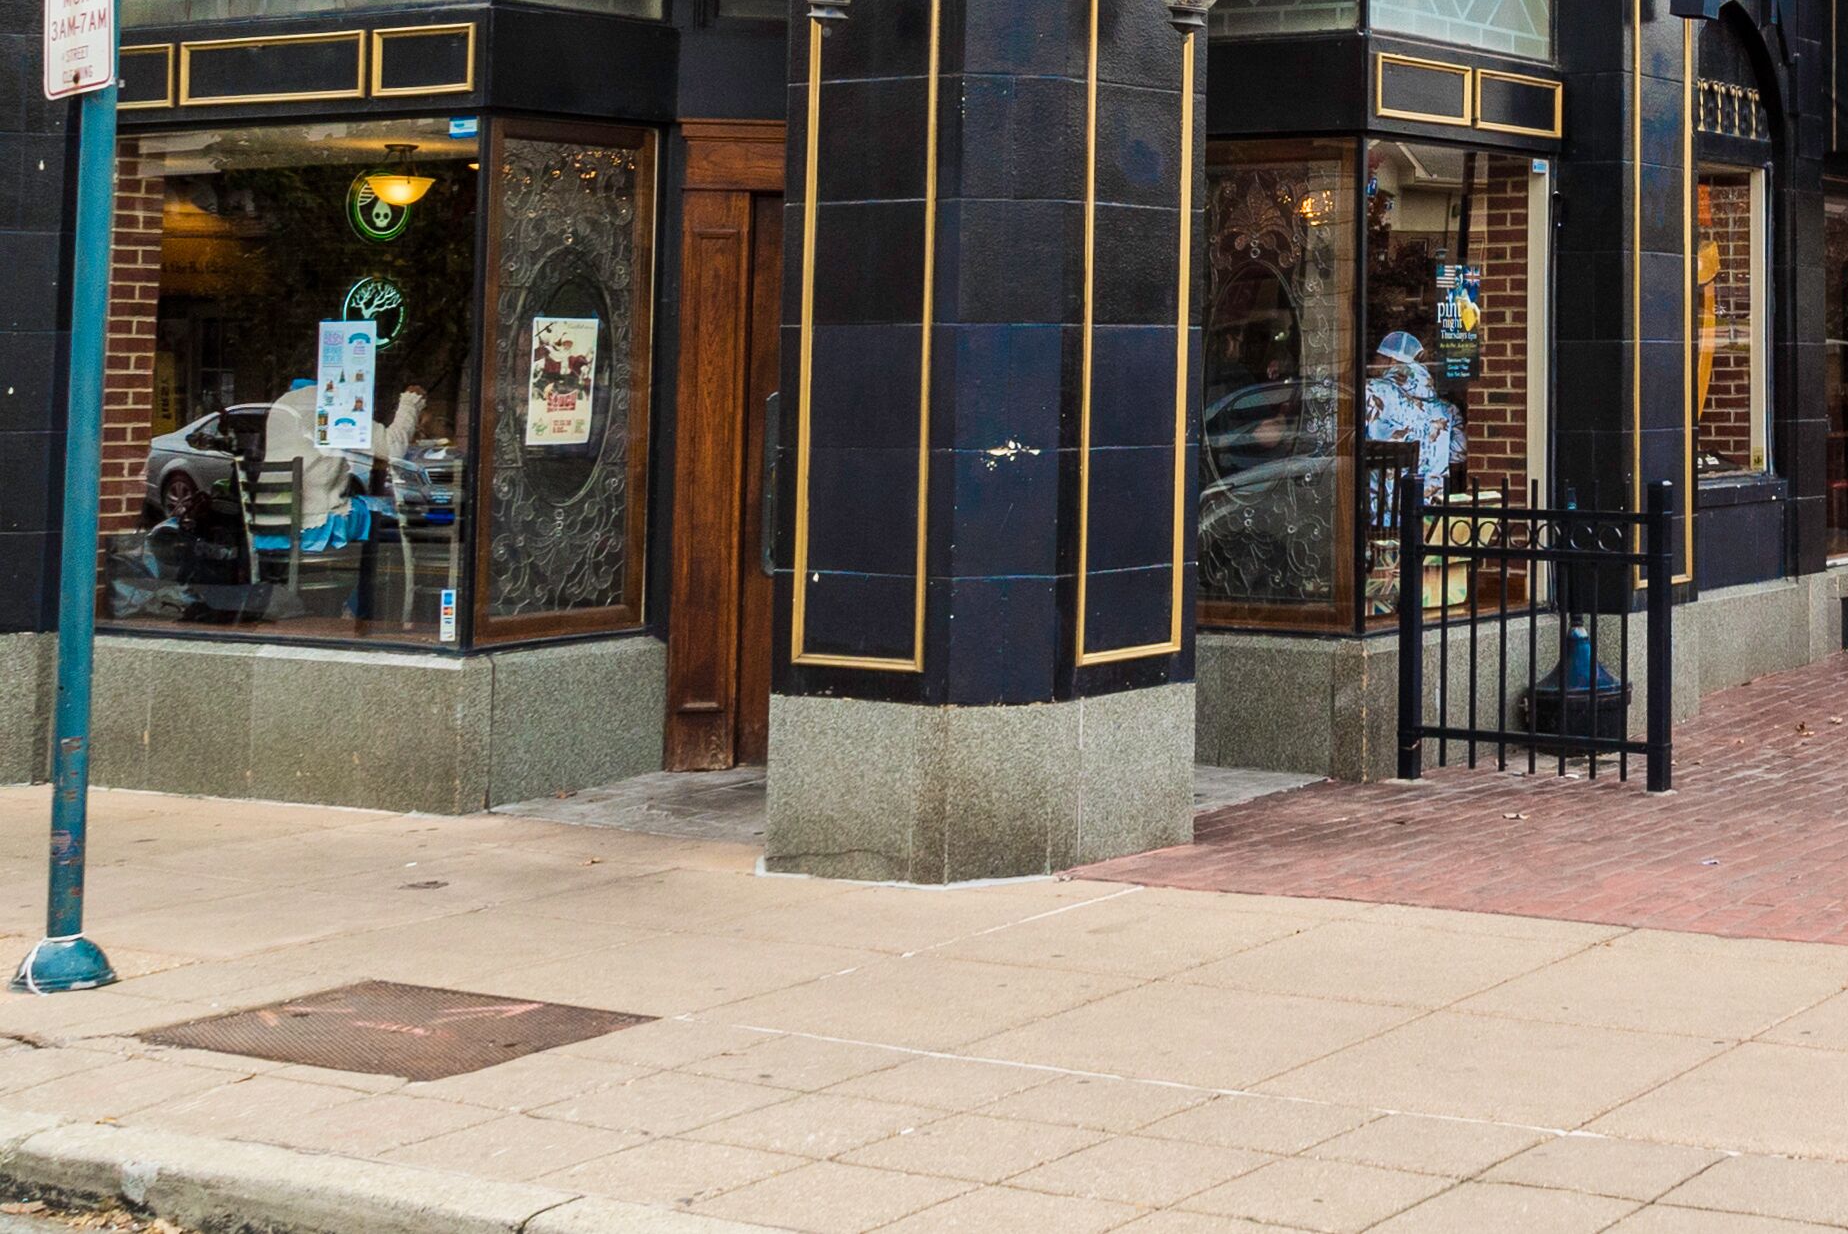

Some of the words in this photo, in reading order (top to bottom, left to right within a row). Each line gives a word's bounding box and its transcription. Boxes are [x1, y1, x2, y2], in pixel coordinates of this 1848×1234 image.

[51, 8, 107, 42] 3AM-7AM
[1437, 296, 1462, 323] pint
[1443, 317, 1463, 332] night
